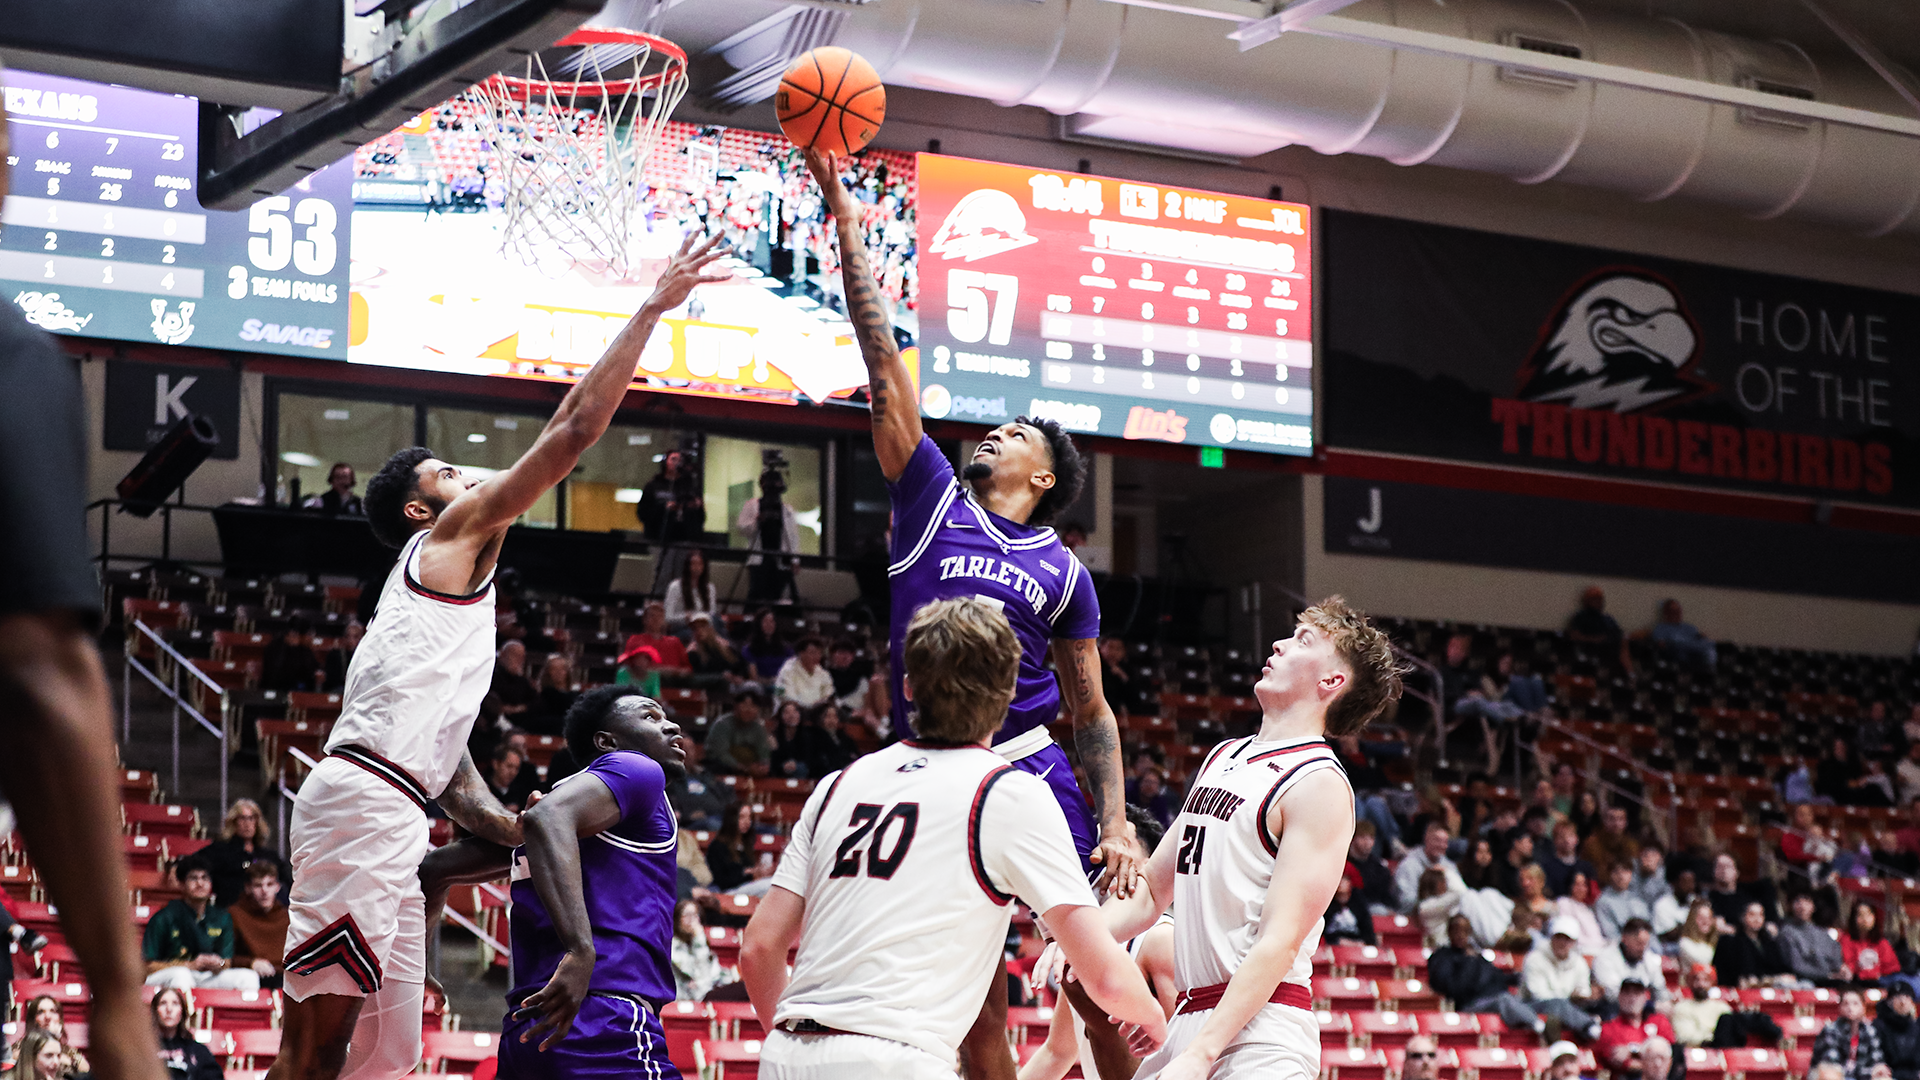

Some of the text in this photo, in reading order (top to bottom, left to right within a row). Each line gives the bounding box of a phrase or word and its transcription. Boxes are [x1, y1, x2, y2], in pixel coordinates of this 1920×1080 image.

[0, 86, 98, 122] EXANS
[46, 131, 184, 161] 6 7 23
[47, 177, 178, 208] 5 25 6
[1164, 191, 1182, 218] 2
[44, 231, 176, 264] 2 2 2
[248, 195, 337, 276] 53
[44, 259, 175, 290] 1 1 4
[228, 265, 338, 304] 3 TEAM FOULS
[947, 268, 1019, 346] 57
[1093, 296, 1106, 314] 7
[238, 318, 335, 347] SAVAGE
[1735, 298, 1890, 364] HOME
[933, 345, 950, 374] 2
[155, 373, 198, 425] K
[1736, 361, 1892, 427] OF THE
[1123, 406, 1189, 443] Lin's
[1491, 398, 1892, 495] THUNDERBIRDS
[1357, 487, 1382, 534] J
[939, 555, 1048, 615] TARLETON
[829, 802, 920, 881] 20
[1176, 824, 1206, 876] 24
